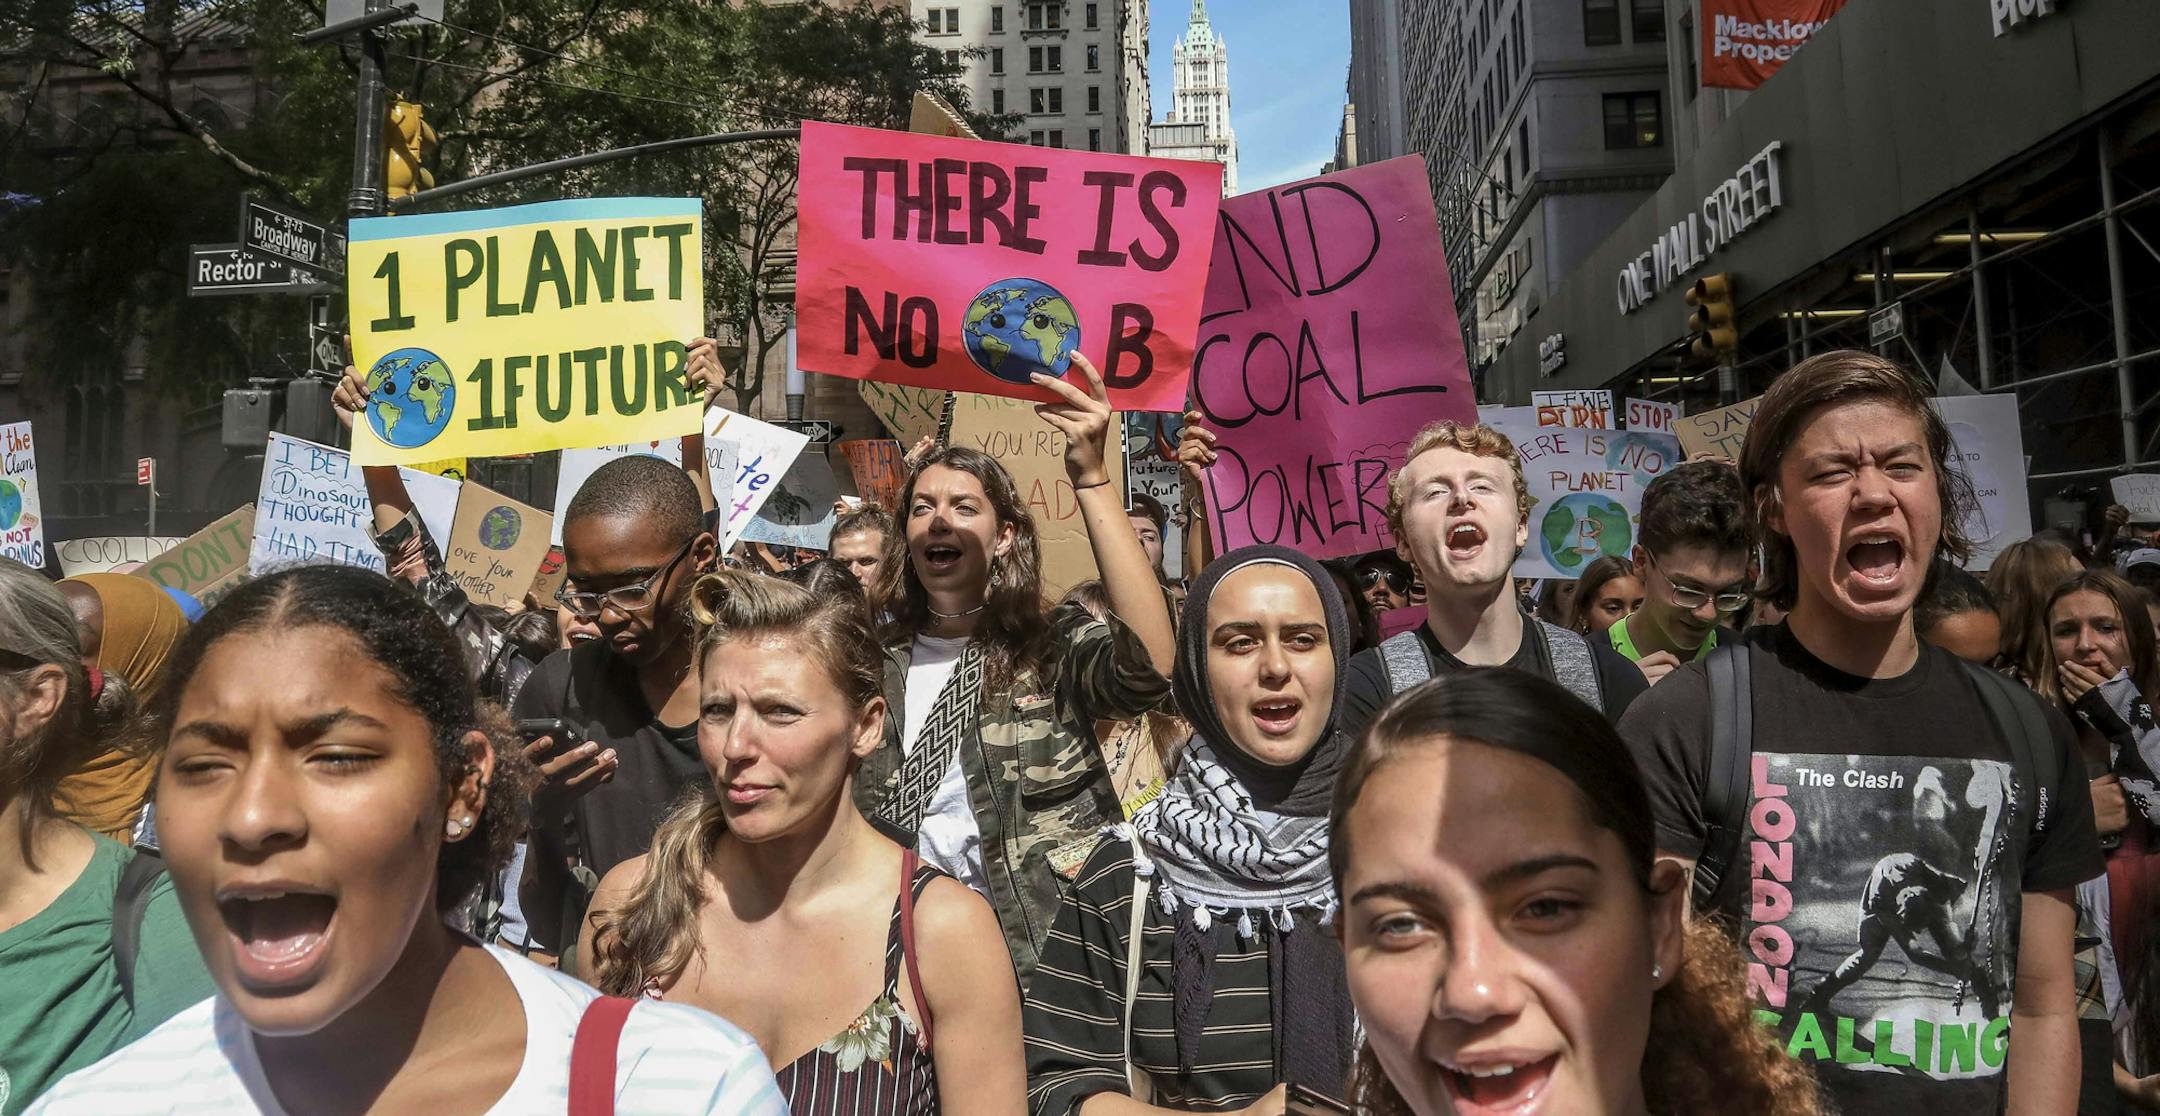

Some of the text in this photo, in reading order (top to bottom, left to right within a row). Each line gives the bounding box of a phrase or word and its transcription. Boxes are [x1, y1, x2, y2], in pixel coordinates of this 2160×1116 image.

[844, 156, 1187, 272] THERE IS
[1617, 140, 1782, 316] ONE WALL STREET
[254, 216, 317, 261] Broadway
[282, 247, 290, 255] OF
[1200, 181, 1380, 309] ND
[198, 258, 266, 283] Rector
[370, 223, 693, 333] 1 PLANET
[844, 285, 1154, 389] NO B
[322, 343, 340, 363] ONE
[1193, 310, 1447, 427] COAL
[1579, 391, 1611, 411] WE
[1629, 403, 1673, 432] STOP
[6, 426, 31, 453] the
[275, 440, 296, 466] I
[975, 430, 1062, 459] YOU'RE
[1584, 434, 1606, 456] IS
[1620, 442, 1662, 474] NO
[5, 452, 34, 476] Clean
[1966, 452, 1981, 461] TO
[735, 455, 770, 492] te
[1141, 479, 1179, 497] Your
[1547, 470, 1632, 492] PLANET
[1027, 478, 1080, 521] AD
[1205, 445, 1390, 554] POWER
[1977, 488, 1997, 497] CAN
[261, 495, 361, 528] THOUGHT
[6, 527, 32, 543] NOT
[62, 537, 139, 563] COOL
[268, 526, 318, 562] HAD
[1573, 517, 1605, 553] B
[149, 518, 247, 592] DONT
[488, 556, 514, 581] YOUR
[451, 569, 497, 601] MOTHER
[1795, 768, 1904, 789] The Clash
[1746, 755, 1797, 1009] LONDON
